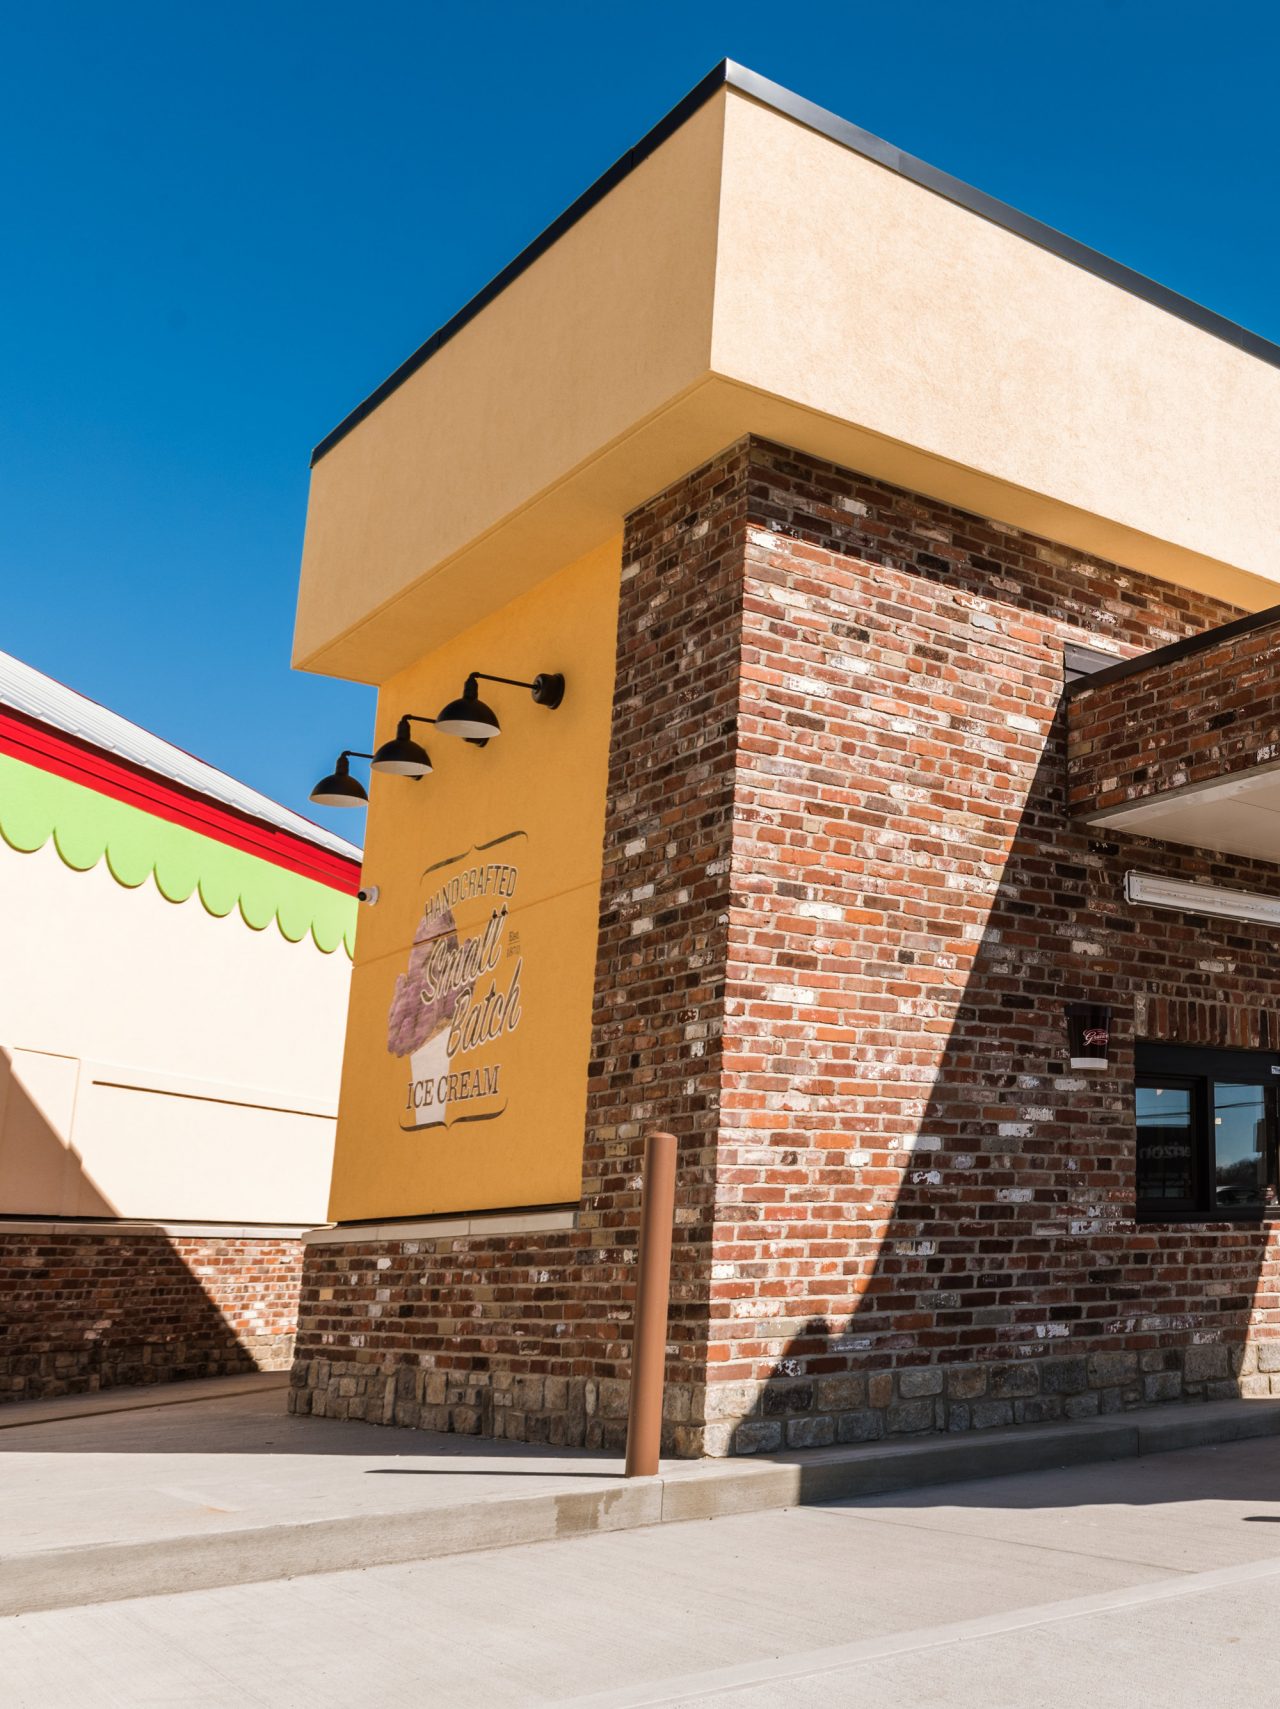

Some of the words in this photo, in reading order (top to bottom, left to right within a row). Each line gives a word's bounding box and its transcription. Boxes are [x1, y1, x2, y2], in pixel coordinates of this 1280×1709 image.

[425, 864, 517, 926] HANDCRAFTED
[421, 902, 507, 1004] Small
[446, 957, 522, 1060] Batch
[406, 1079, 434, 1110] ICE
[437, 1065, 500, 1104] CREAM
